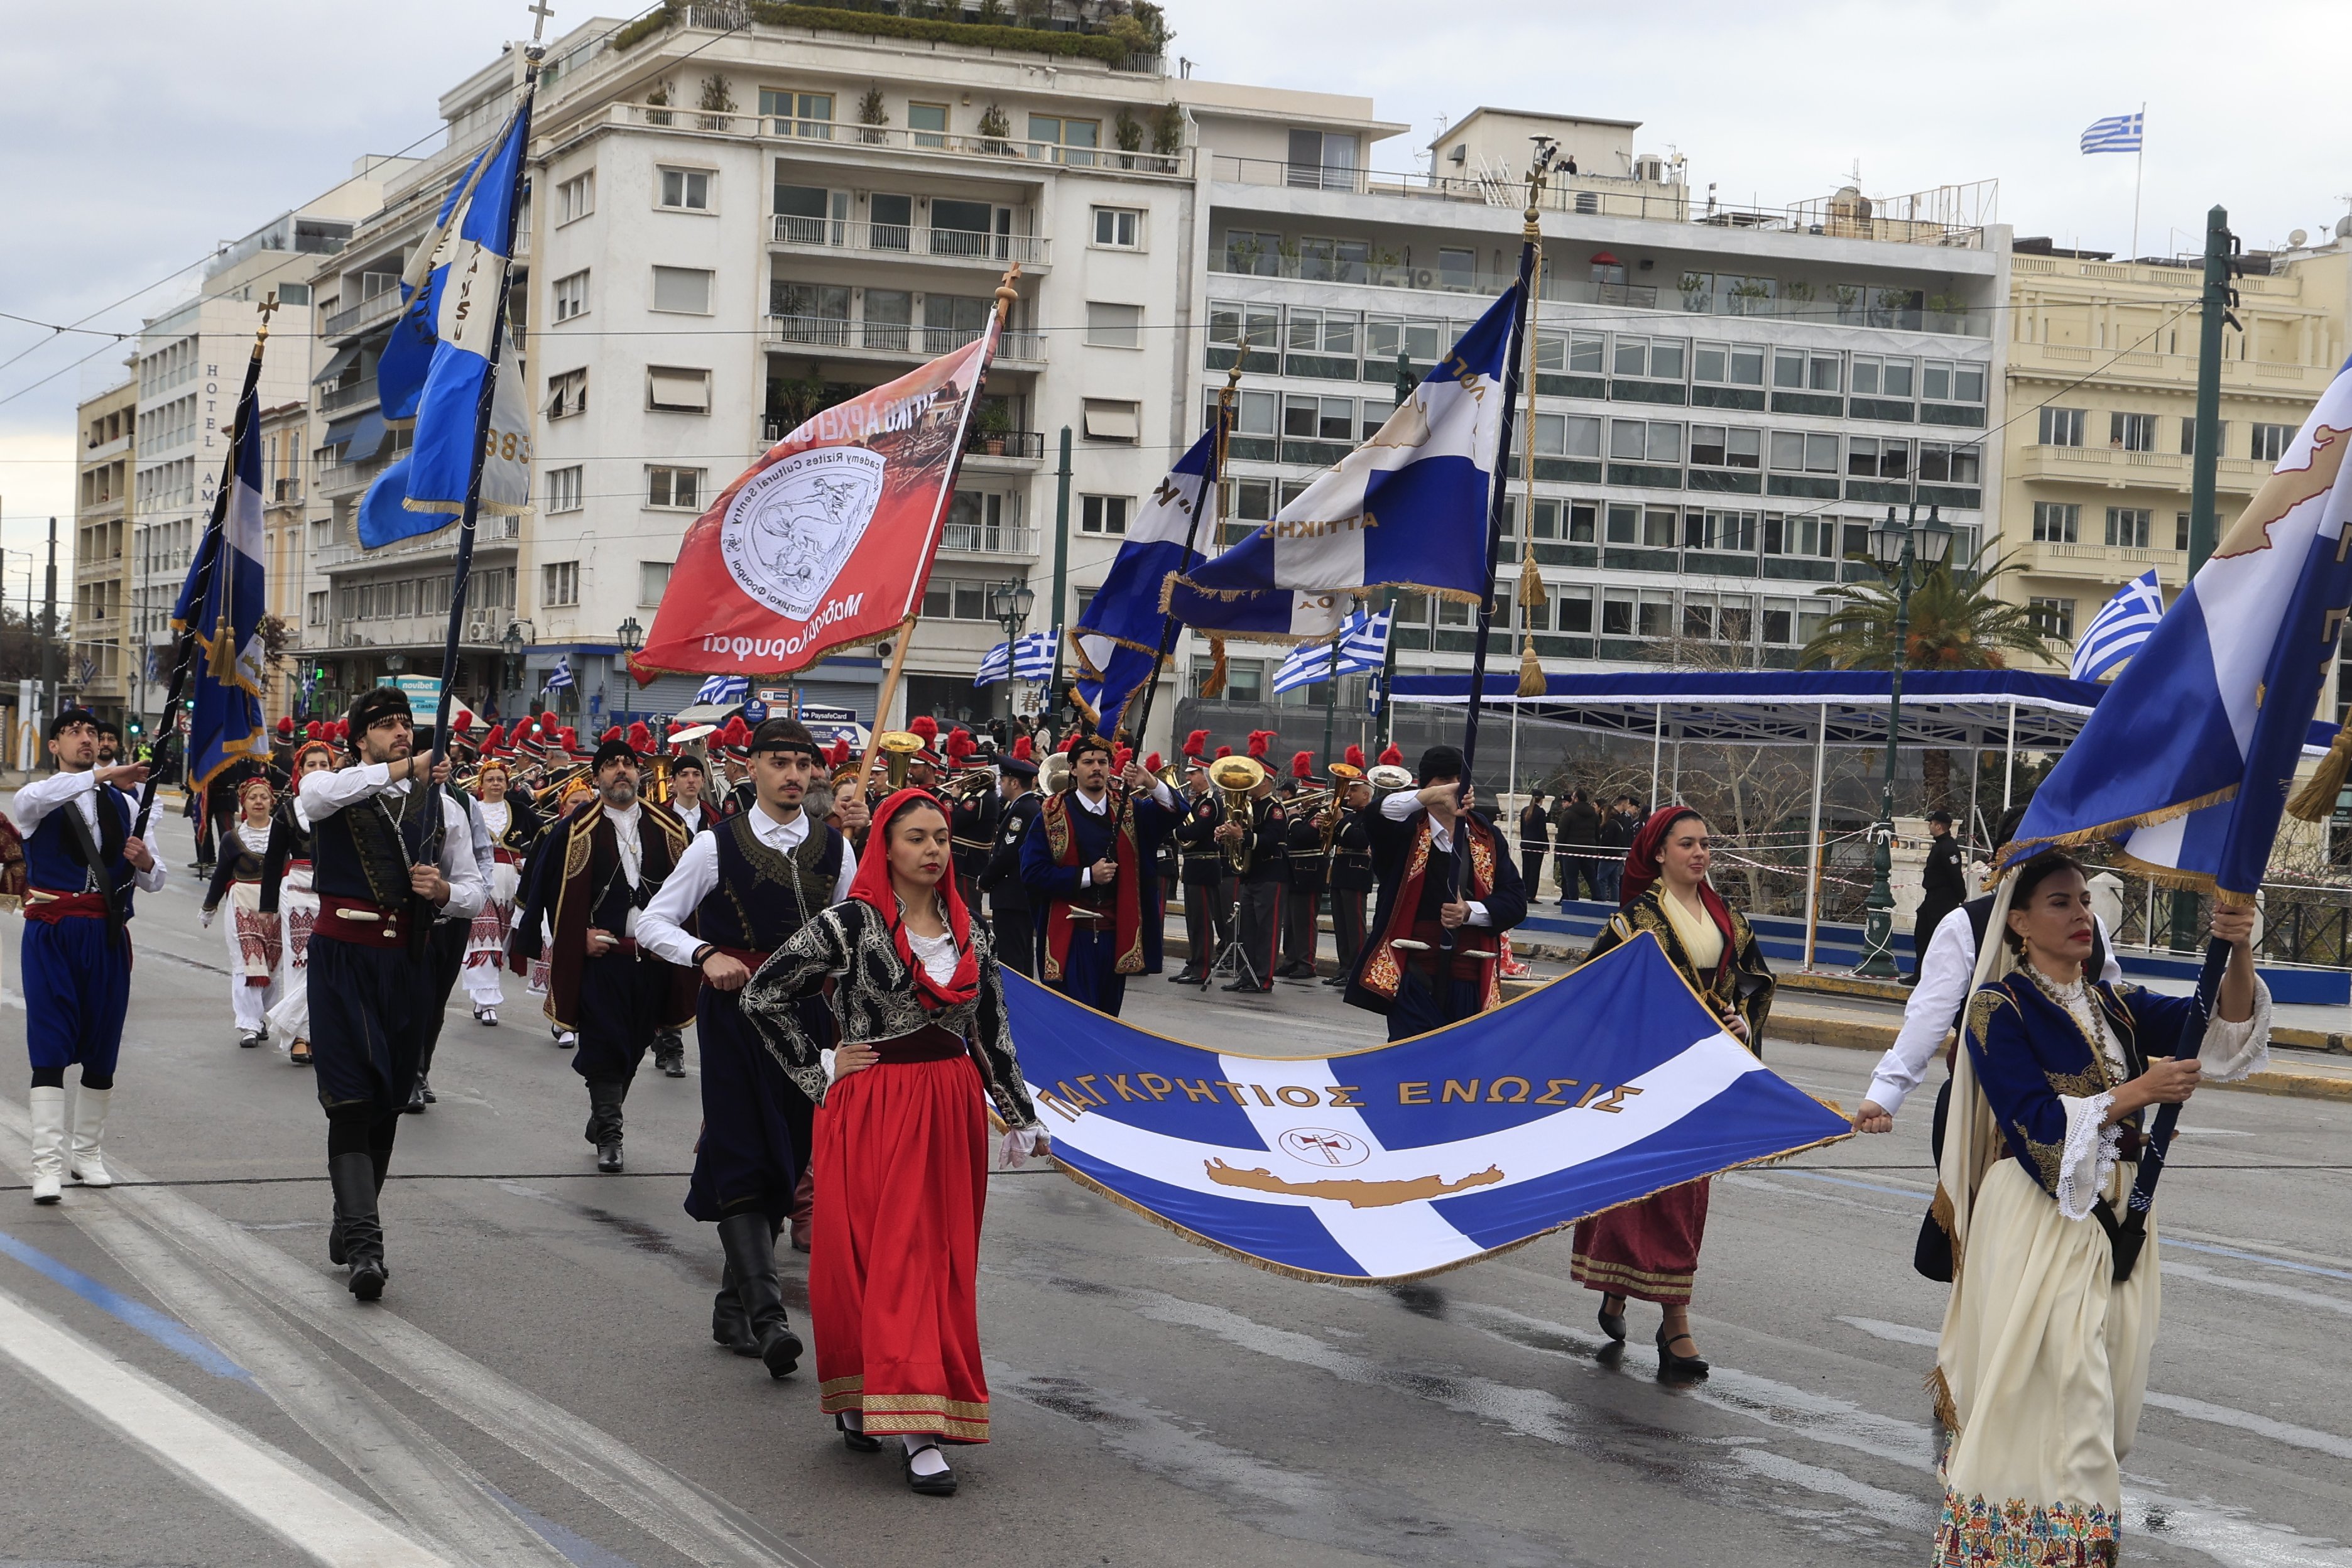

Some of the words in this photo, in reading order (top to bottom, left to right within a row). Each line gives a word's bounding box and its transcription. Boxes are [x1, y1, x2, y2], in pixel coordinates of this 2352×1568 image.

[206, 364, 218, 447] HOTEL
[202, 472, 215, 536] AMA
[402, 681, 433, 690] novibet
[1020, 691, 1040, 712] 春
[811, 712, 847, 720] PaysafeCard
[1037, 1072, 1367, 1123] ΠΑΓΚΡΗΤΙΟΣ
[1397, 1075, 1645, 1114] ΕΝΩΣΙΣ
